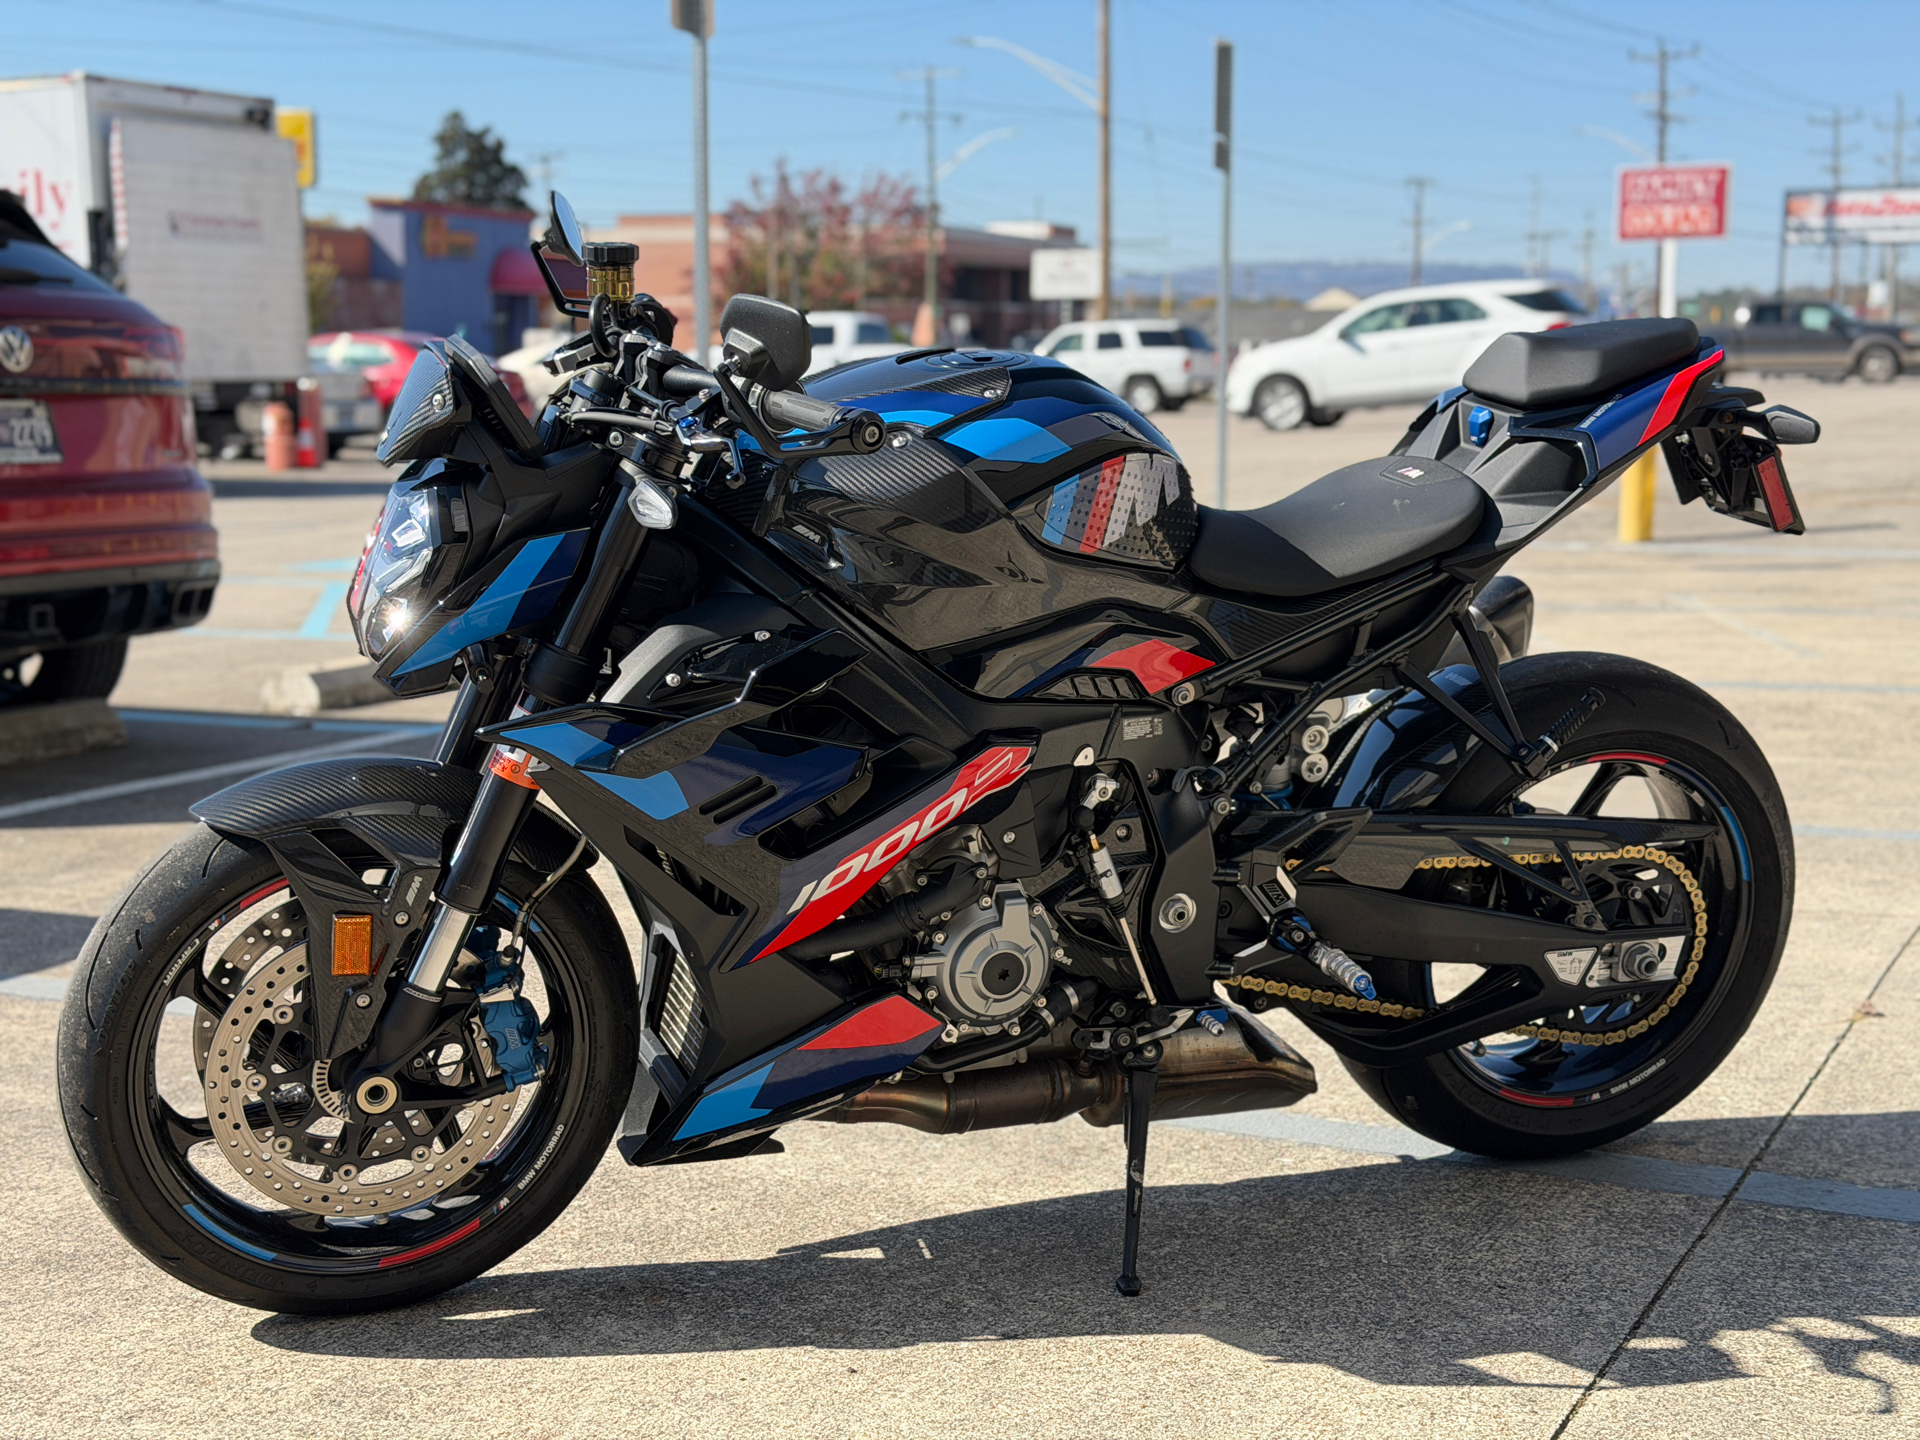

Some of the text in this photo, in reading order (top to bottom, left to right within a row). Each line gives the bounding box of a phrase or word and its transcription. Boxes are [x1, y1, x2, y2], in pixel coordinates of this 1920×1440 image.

[1556, 950, 1574, 959] BMW
[97, 958, 137, 1046] DUNLOP
[1609, 1057, 1667, 1095] BMW MOTORRAD
[516, 1123, 566, 1191] BMW MOTORRAD
